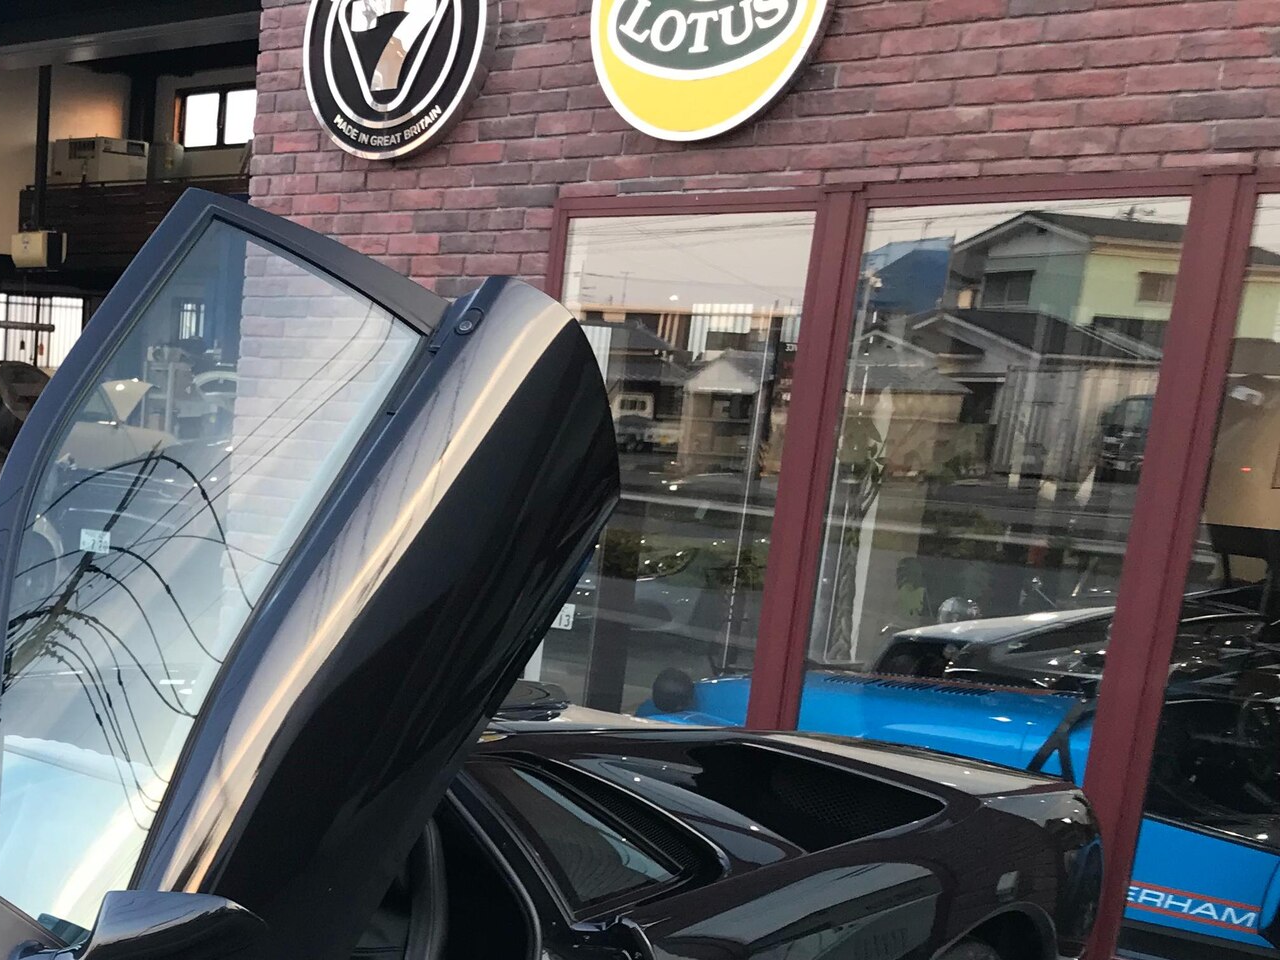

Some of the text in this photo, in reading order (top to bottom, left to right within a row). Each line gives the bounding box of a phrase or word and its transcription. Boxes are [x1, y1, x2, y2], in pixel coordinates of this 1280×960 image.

[619, 0, 788, 53] LOTUS
[333, 105, 442, 146] MADE IN GREAT BRITAIN
[1127, 886, 1256, 927] ERHAM
